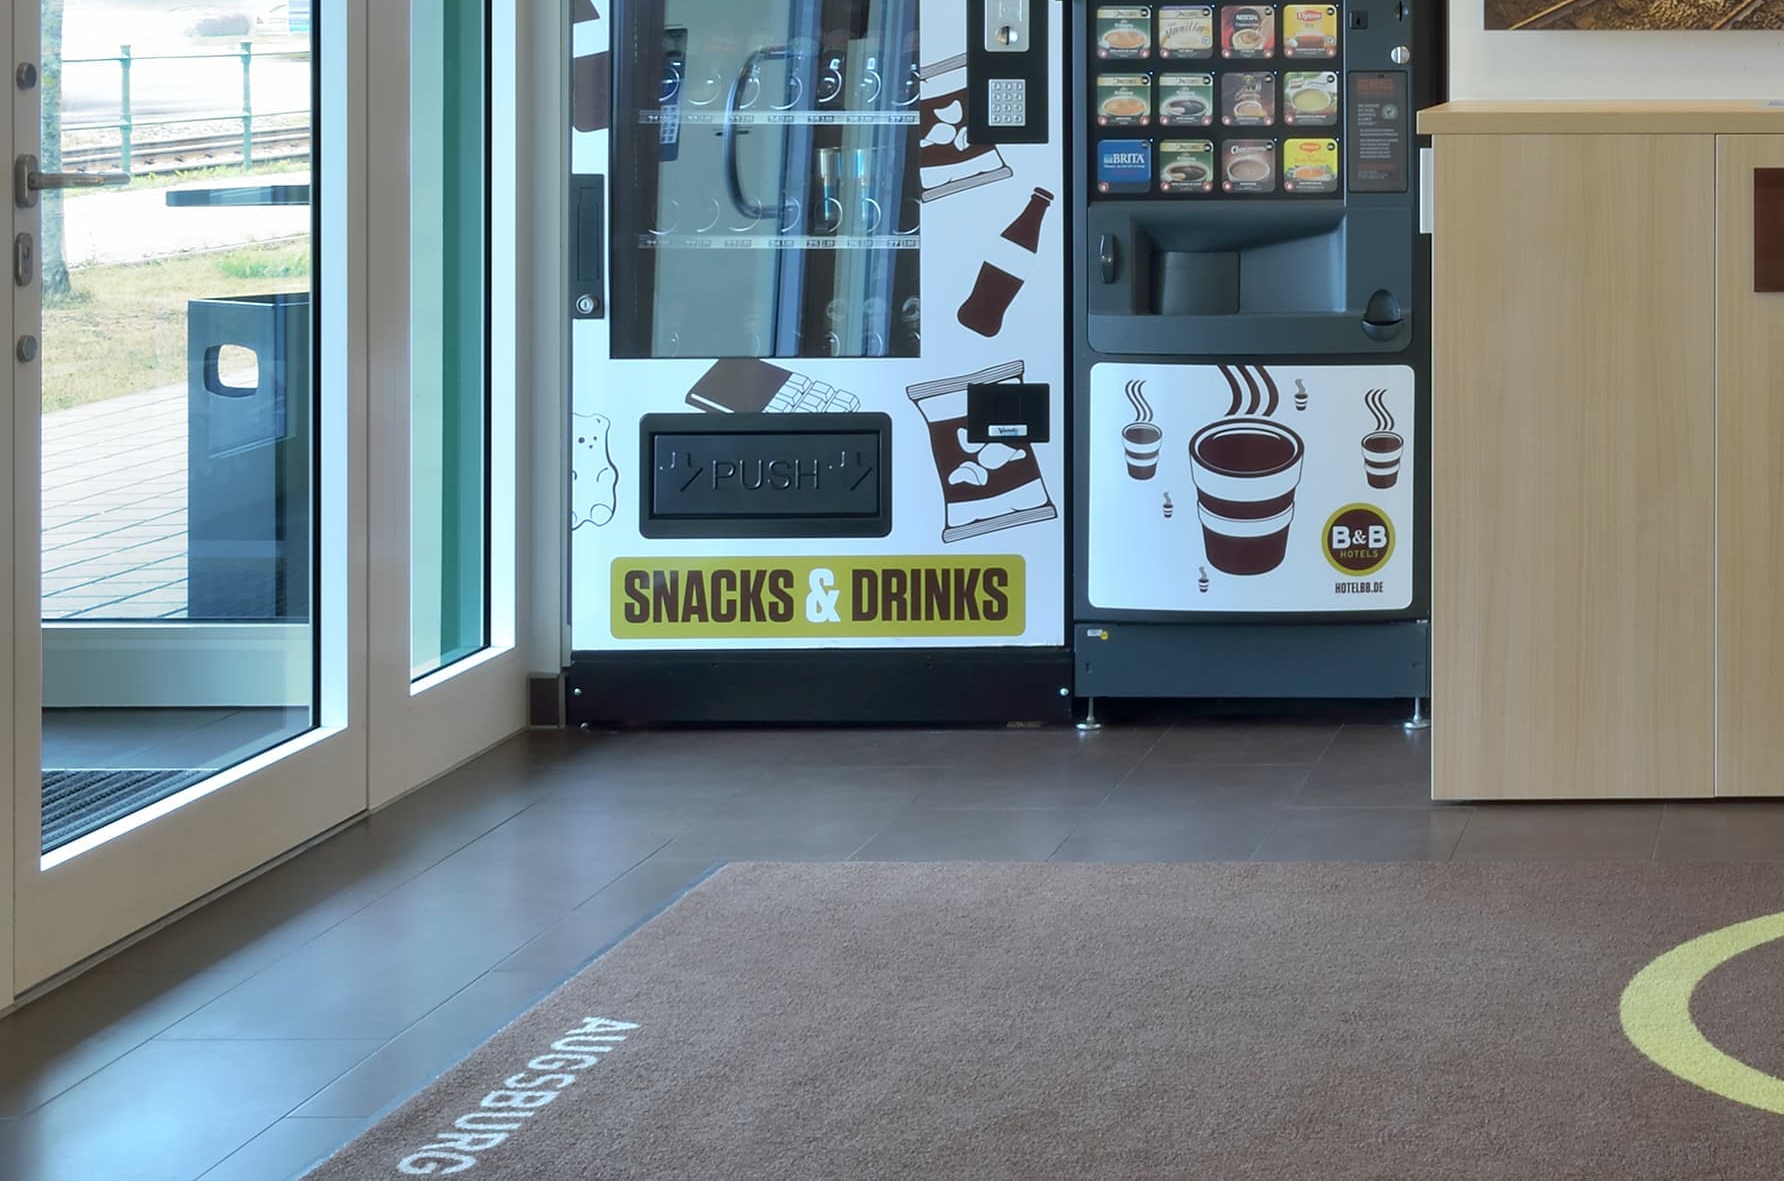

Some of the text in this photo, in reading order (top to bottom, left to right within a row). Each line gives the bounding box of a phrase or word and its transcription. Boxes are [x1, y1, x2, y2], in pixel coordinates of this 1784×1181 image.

[1113, 153, 1145, 164] BRITA
[712, 459, 820, 490] PUSH
[1332, 525, 1387, 549] B&B
[1339, 550, 1379, 558] HOTELS
[624, 567, 1009, 624] SNACKS & DRINKS
[1335, 581, 1384, 594] HOTELBB.DE
[397, 1016, 641, 1175] AUGSBURG
